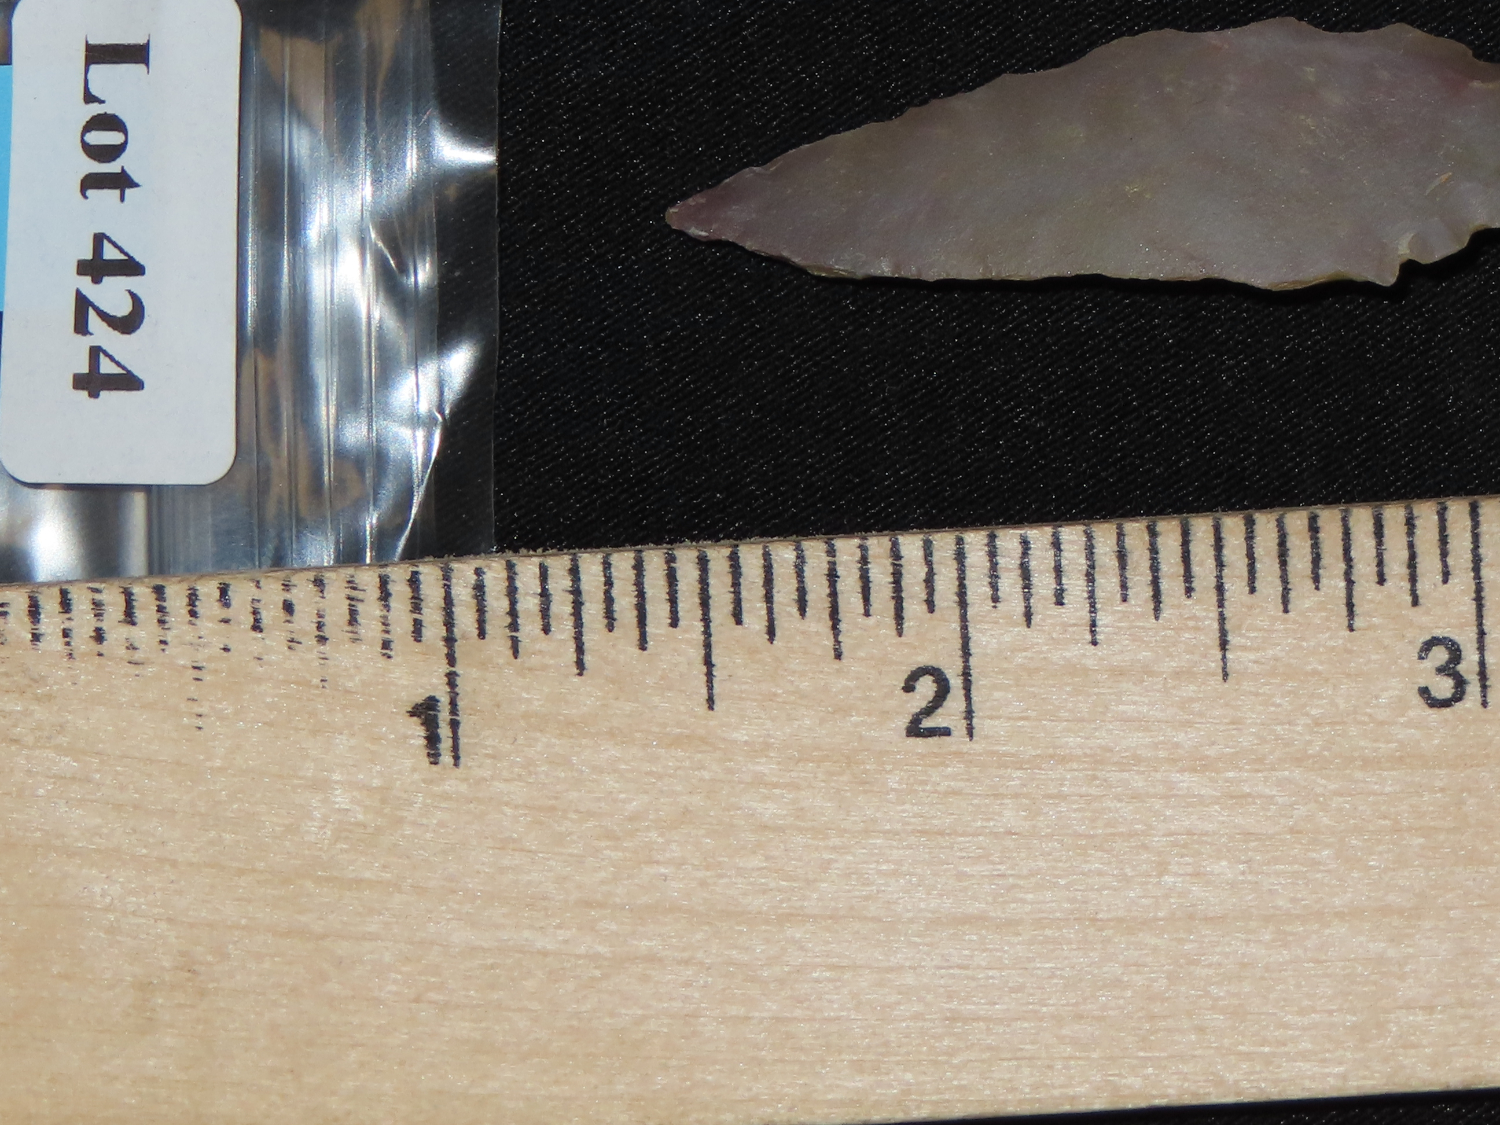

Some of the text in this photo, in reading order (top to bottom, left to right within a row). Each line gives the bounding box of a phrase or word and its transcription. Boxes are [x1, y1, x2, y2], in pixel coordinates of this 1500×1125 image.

[72, 33, 151, 399] Lot 424
[901, 665, 953, 739] 2
[1416, 635, 1469, 710] 3
[406, 694, 442, 766] 1
